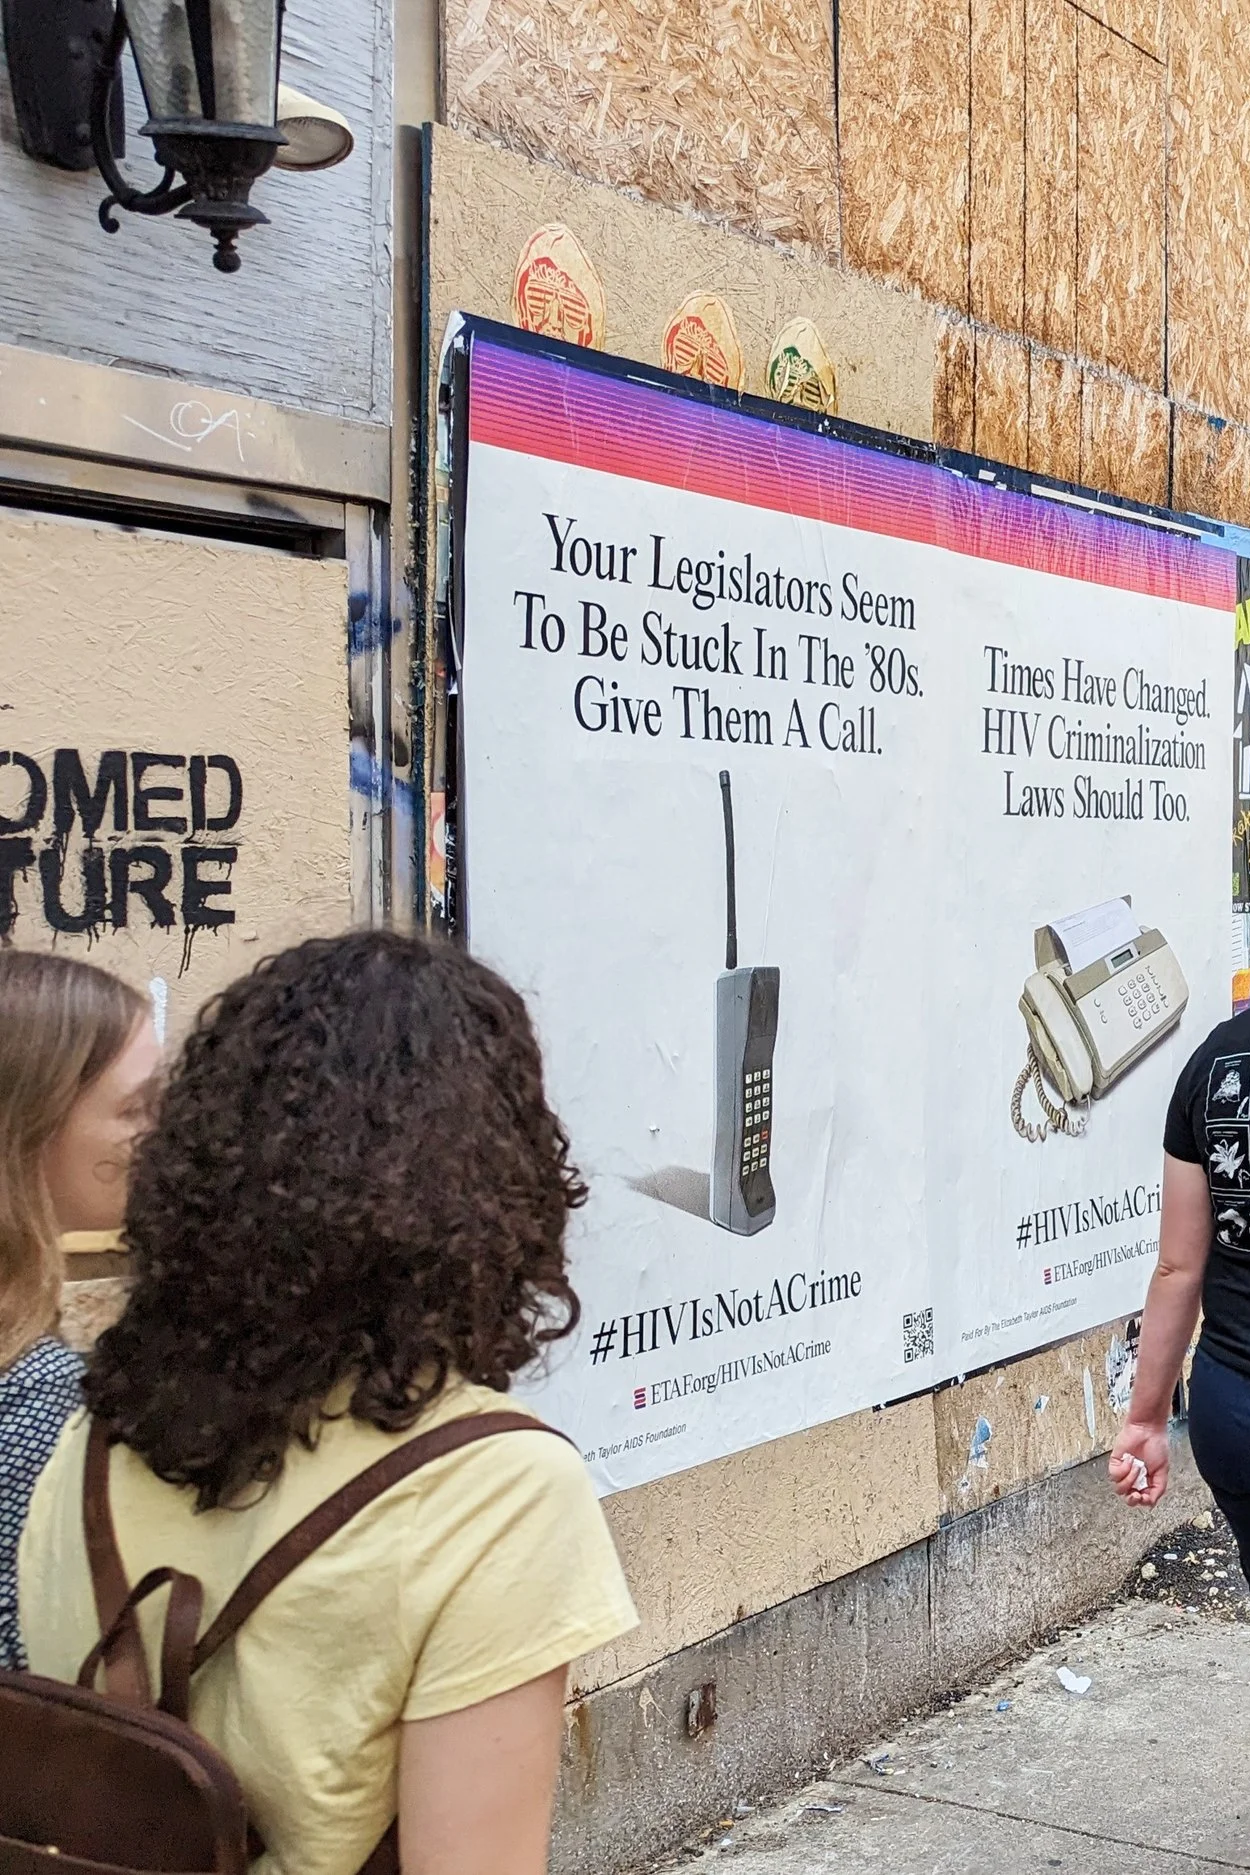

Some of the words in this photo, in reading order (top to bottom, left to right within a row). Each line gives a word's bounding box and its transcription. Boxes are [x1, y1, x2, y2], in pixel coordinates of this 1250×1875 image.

[542, 512, 637, 583] Your
[648, 534, 833, 617] Legislators
[840, 572, 916, 631] Seem
[514, 590, 565, 653] To
[577, 600, 628, 662] Be
[641, 610, 743, 676] Stuck
[753, 627, 789, 681] In
[799, 634, 855, 690] The
[574, 675, 662, 737] Give
[672, 685, 773, 746] Them
[782, 698, 812, 749] A
[818, 700, 883, 756] Call.
[984, 645, 1055, 700] Times
[1061, 657, 1117, 707] Have
[1123, 667, 1211, 727] Changed.
[981, 706, 1041, 758] HIV
[1048, 714, 1206, 770] Criminalization
[1003, 770, 1065, 818] Laws
[1073, 774, 1144, 821] Should
[1150, 780, 1190, 822] Too.
[1233, 902, 1244, 912] OW
[1016, 1183, 1162, 1250] #HIVIsNotACri
[1054, 1238, 1160, 1283] ETAF.org/HIVIsNotACrim
[590, 1269, 862, 1365] #HIVIsNotACrime
[651, 1339, 831, 1406] ETAF.org/HIVIsNotACrime
[583, 1450, 596, 1463] eth
[598, 1443, 622, 1459] Taylor
[623, 1434, 644, 1452] AIDS
[645, 1423, 687, 1444] Foundation
